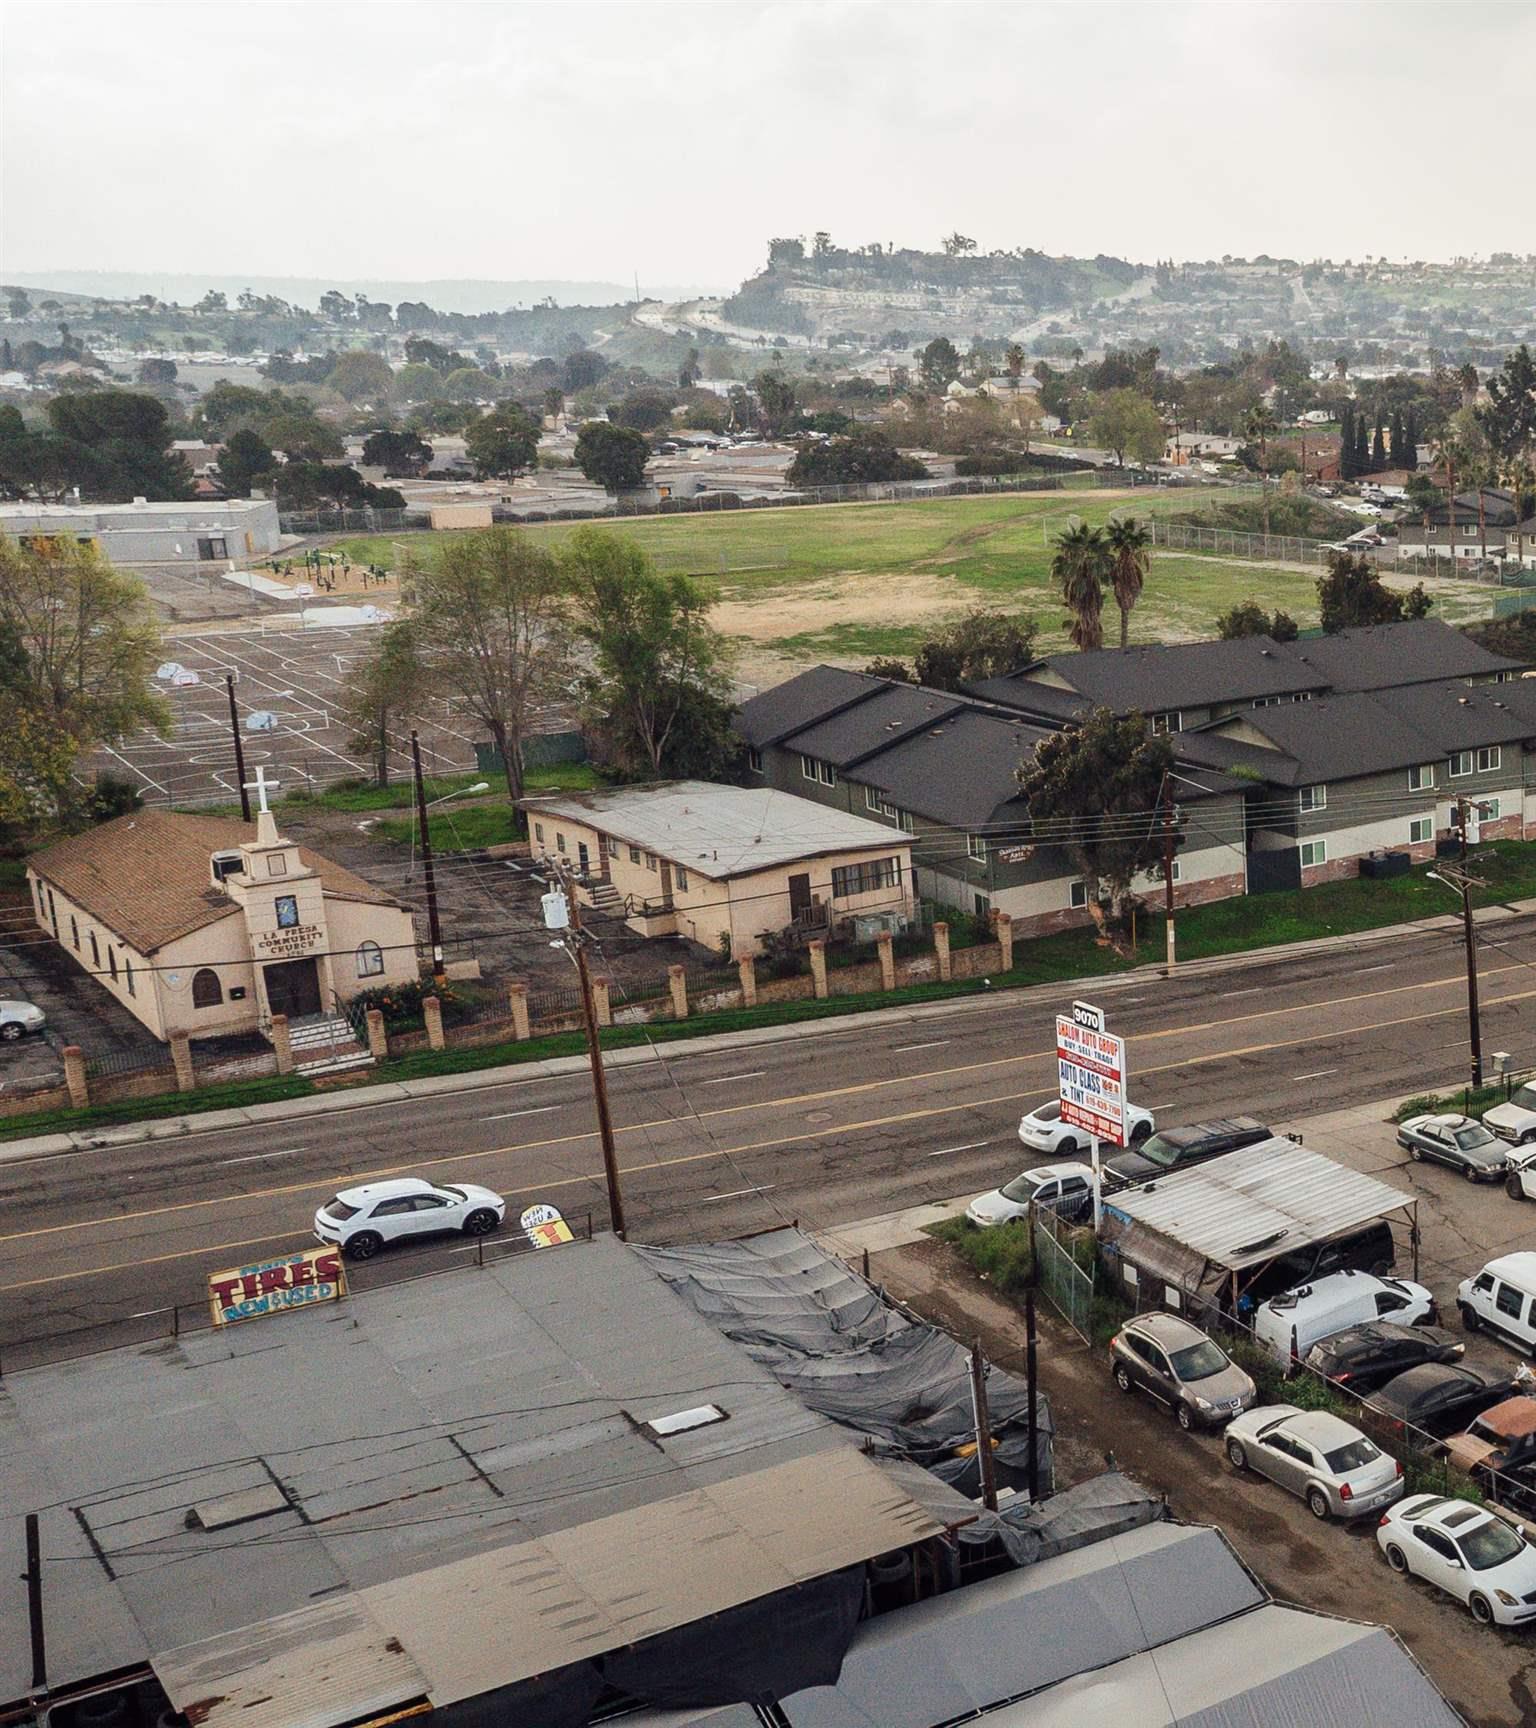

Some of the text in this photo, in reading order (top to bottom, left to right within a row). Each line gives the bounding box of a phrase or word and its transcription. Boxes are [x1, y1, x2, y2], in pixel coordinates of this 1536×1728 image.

[259, 932, 323, 948] COMMUNITY
[264, 925, 317, 941] LA PRESA
[271, 941, 314, 953] CHURCH
[1074, 1007, 1098, 1029] 9070
[1082, 1030, 1098, 1050] AUTO
[1099, 1037, 1118, 1057] GROUP
[1094, 1051, 1113, 1065] TRADE
[1060, 1061, 1077, 1085] AUTO
[1079, 1068, 1101, 1095] GLASS
[1070, 1085, 1084, 1105] TINT
[210, 1253, 341, 1309] TIRES
[223, 1295, 270, 1321] NEW
[283, 1283, 332, 1306] USED
